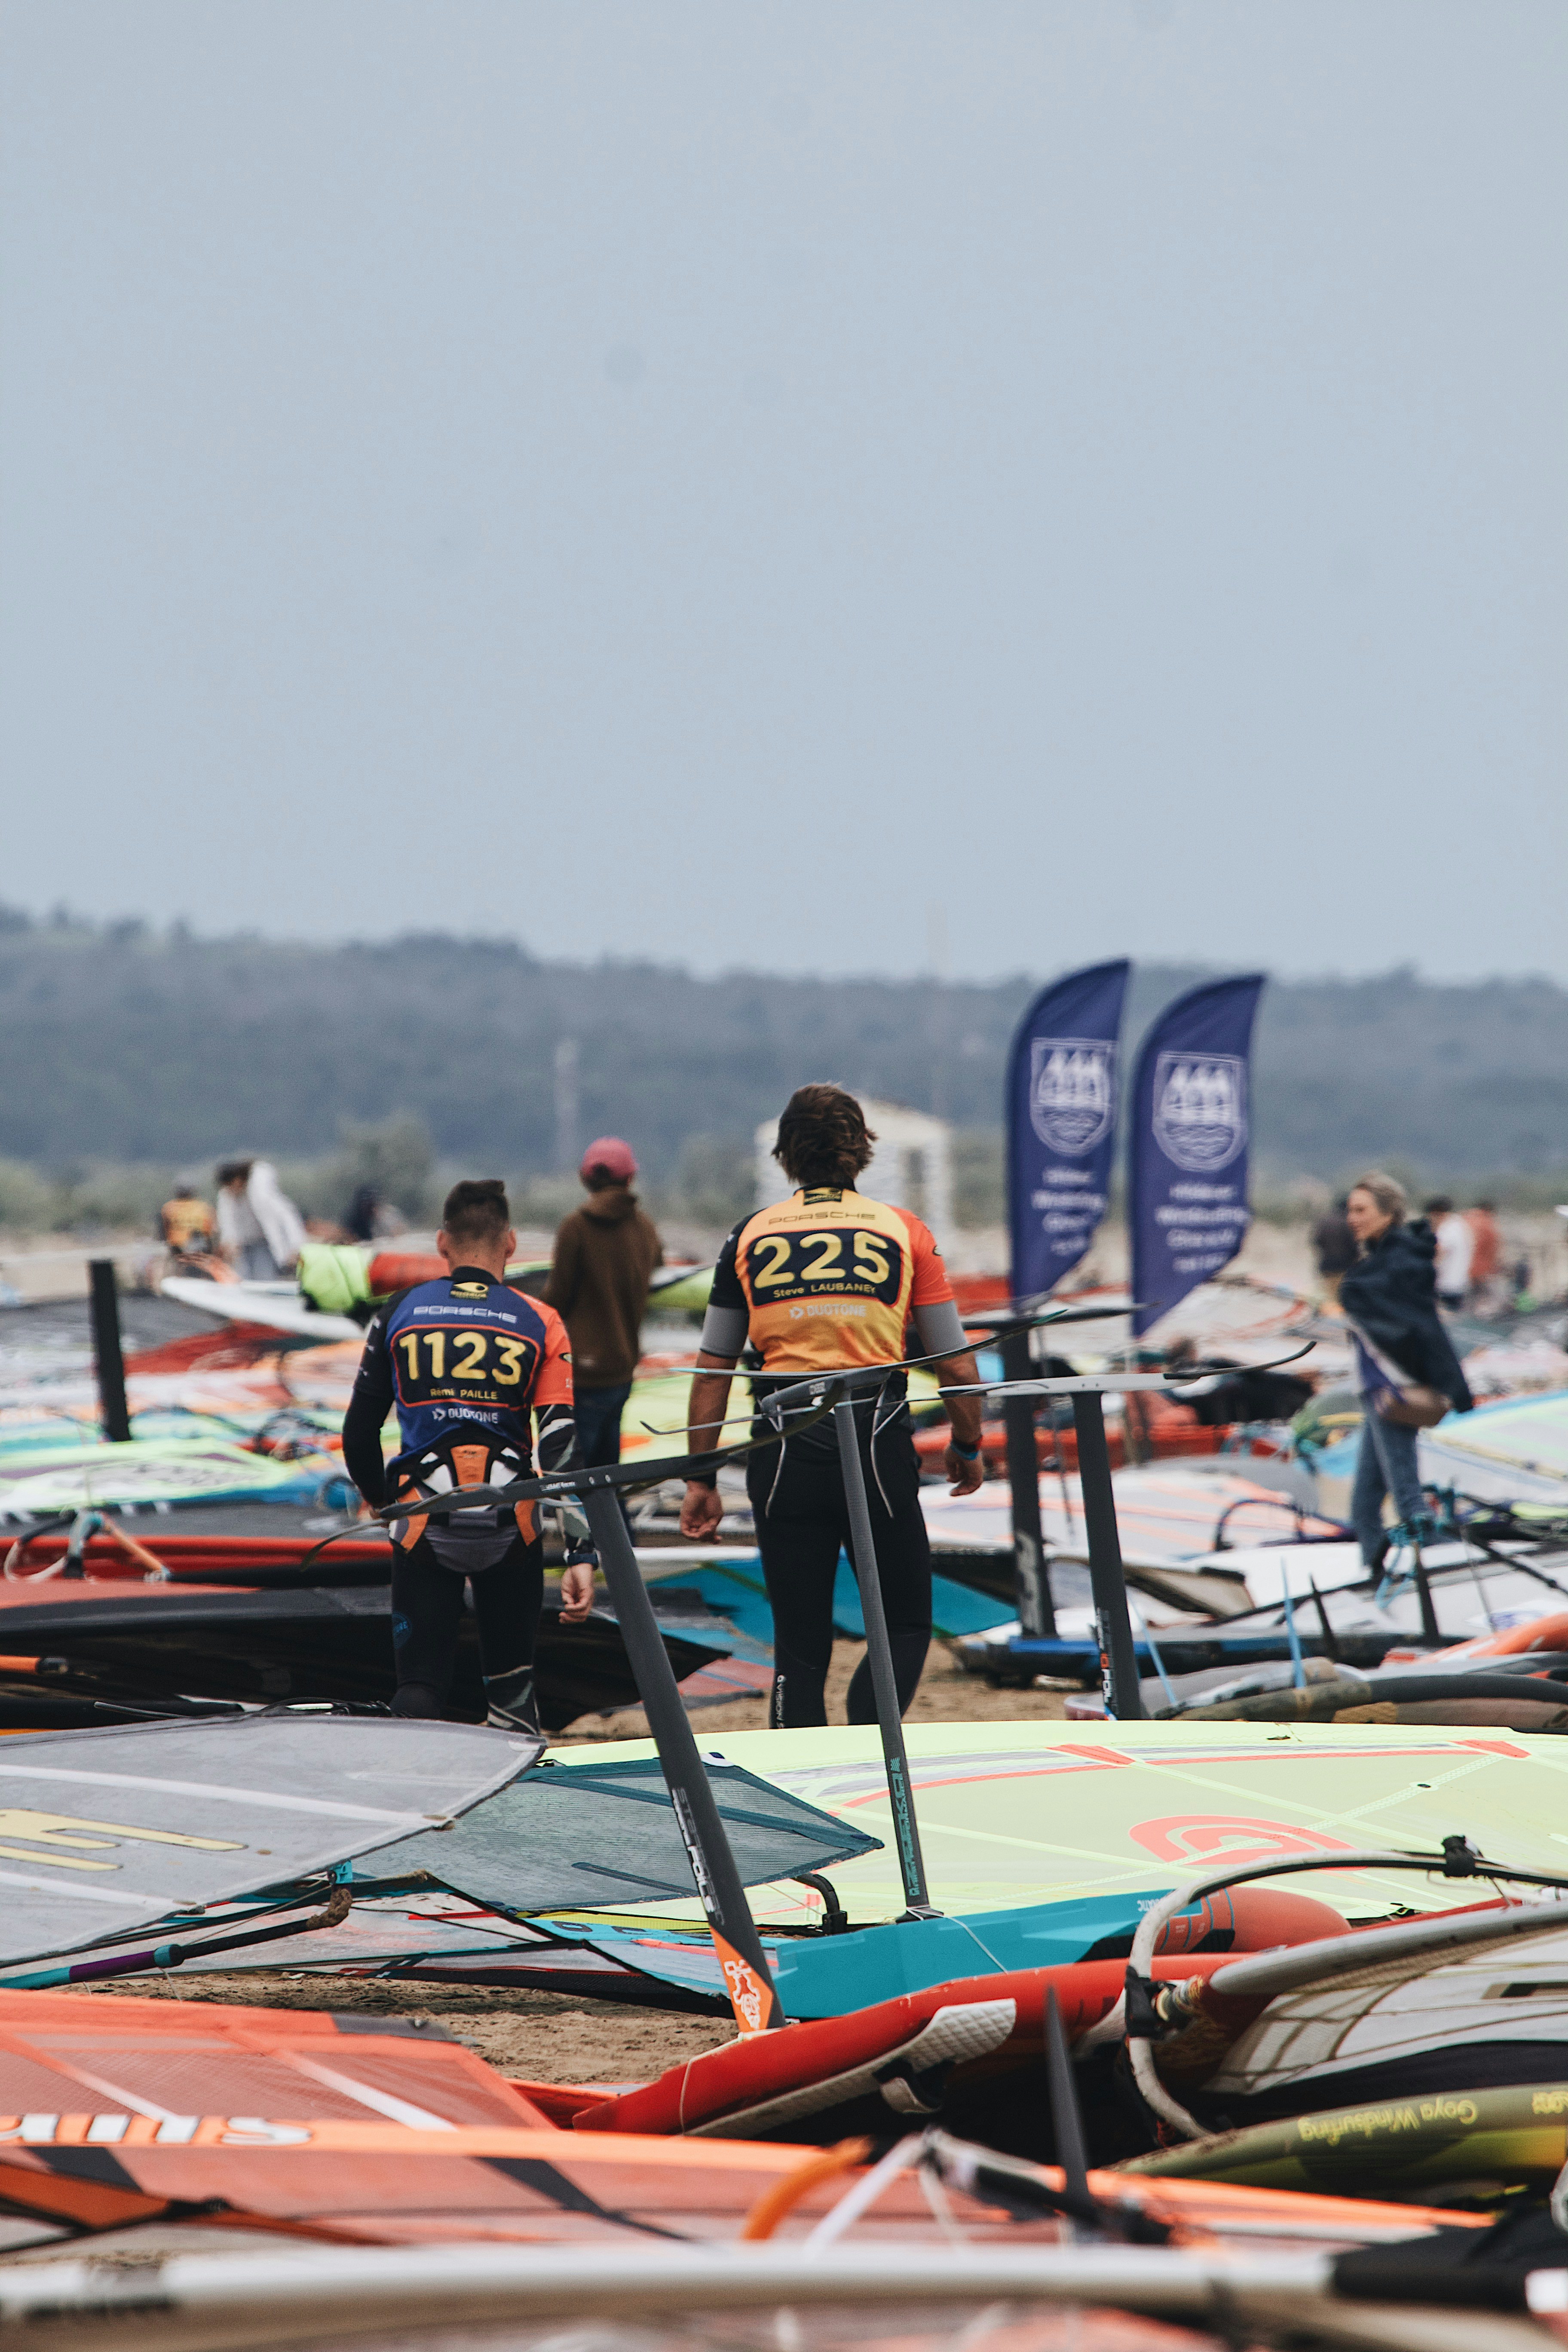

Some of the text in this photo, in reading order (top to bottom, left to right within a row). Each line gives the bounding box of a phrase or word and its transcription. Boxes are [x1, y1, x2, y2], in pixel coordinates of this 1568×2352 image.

[768, 1211, 876, 1225] PORSCHE
[753, 1231, 890, 1289] 225
[773, 1287, 805, 1298] Steve
[413, 1305, 518, 1324] PORSCHE
[806, 1304, 867, 1317] DUOTONE
[398, 1331, 527, 1385] 1123
[460, 1389, 498, 1400] PAILLE
[448, 1408, 499, 1424] DUOTONE
[1297, 2097, 1478, 2145] Goya Windsurfing
